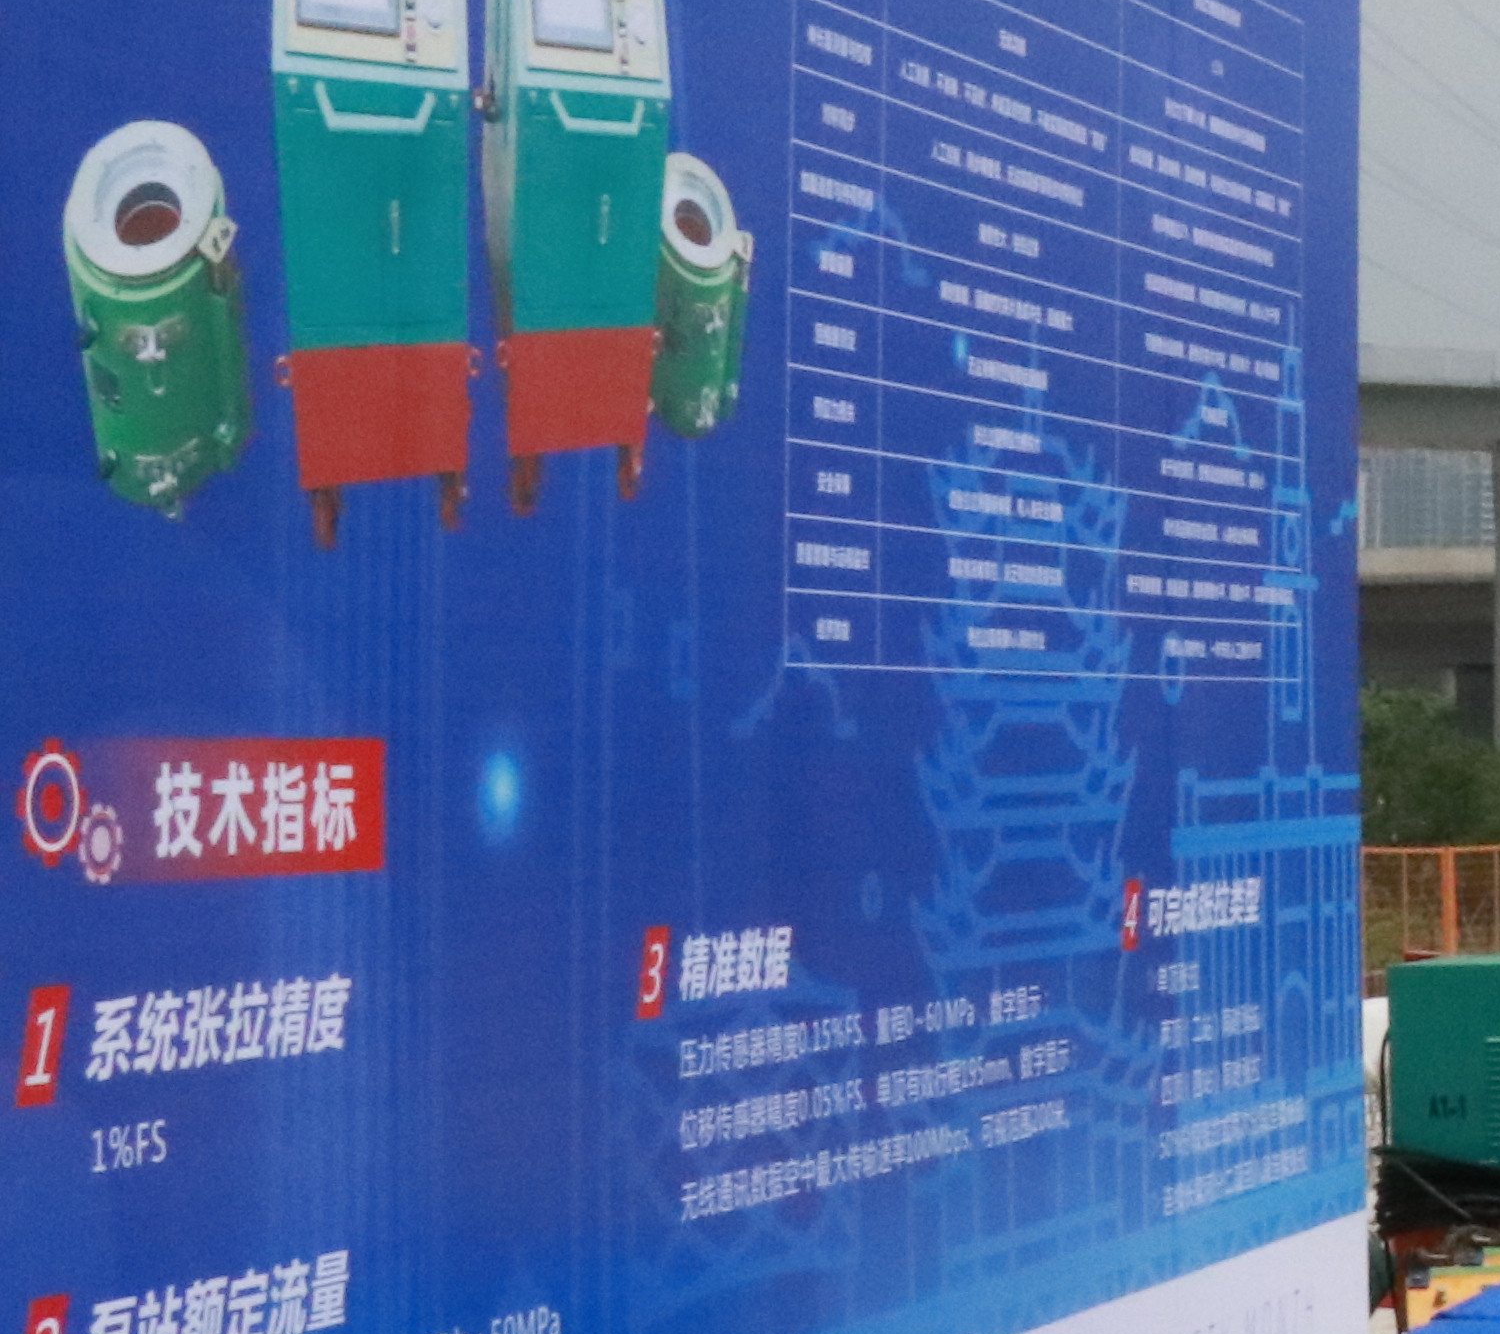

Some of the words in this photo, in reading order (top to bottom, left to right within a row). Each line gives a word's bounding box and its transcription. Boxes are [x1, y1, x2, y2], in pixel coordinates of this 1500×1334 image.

[153, 761, 359, 861] 技术指标
[642, 942, 665, 1006] 3
[679, 925, 794, 1003] 精准数据
[23, 1006, 58, 1088] 1
[84, 973, 353, 1083] 系统张拉精度
[88, 1118, 169, 1175] 1%FS
